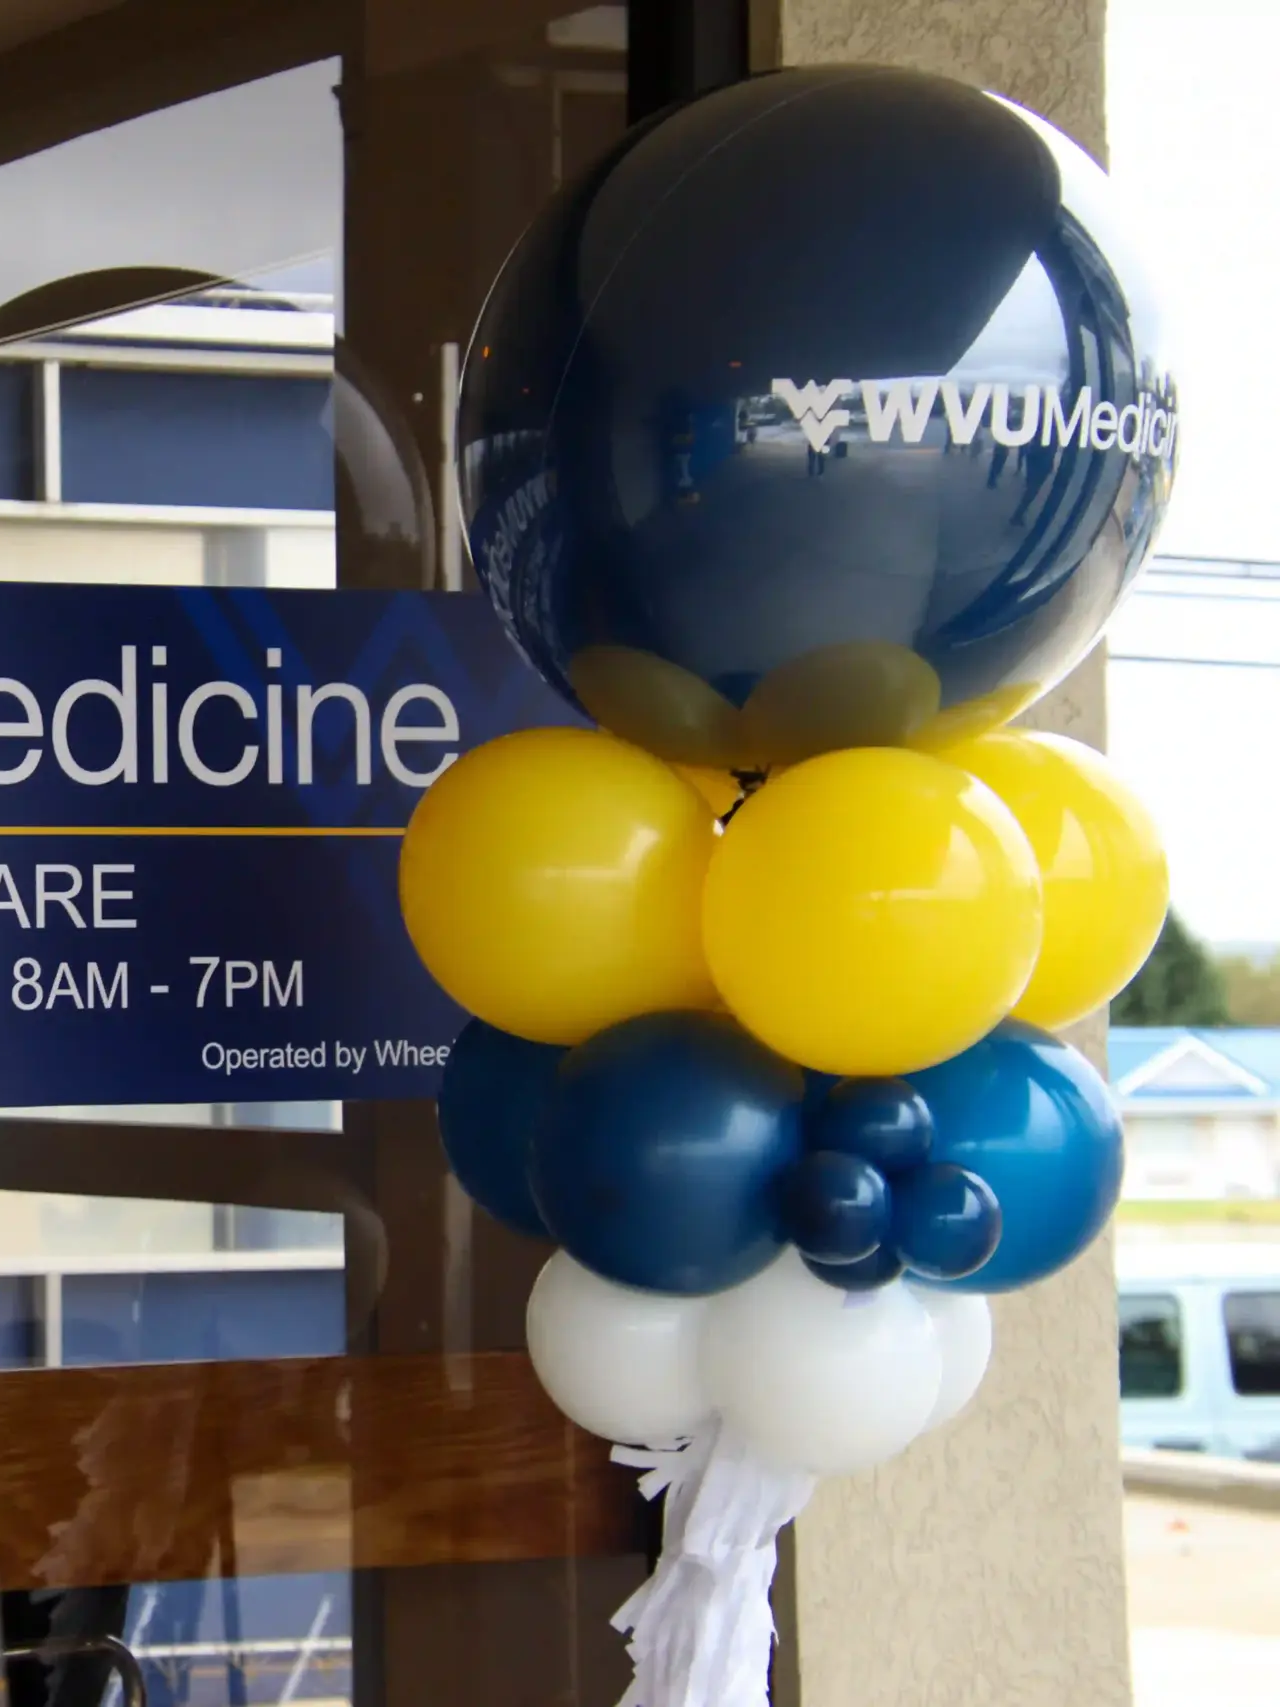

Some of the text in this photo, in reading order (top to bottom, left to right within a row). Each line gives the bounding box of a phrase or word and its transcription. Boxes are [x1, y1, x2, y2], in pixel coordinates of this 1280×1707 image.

[11, 957, 129, 1011] 8AM
[188, 956, 304, 1008] 7PM
[201, 1039, 456, 1076] Operated by Whee
